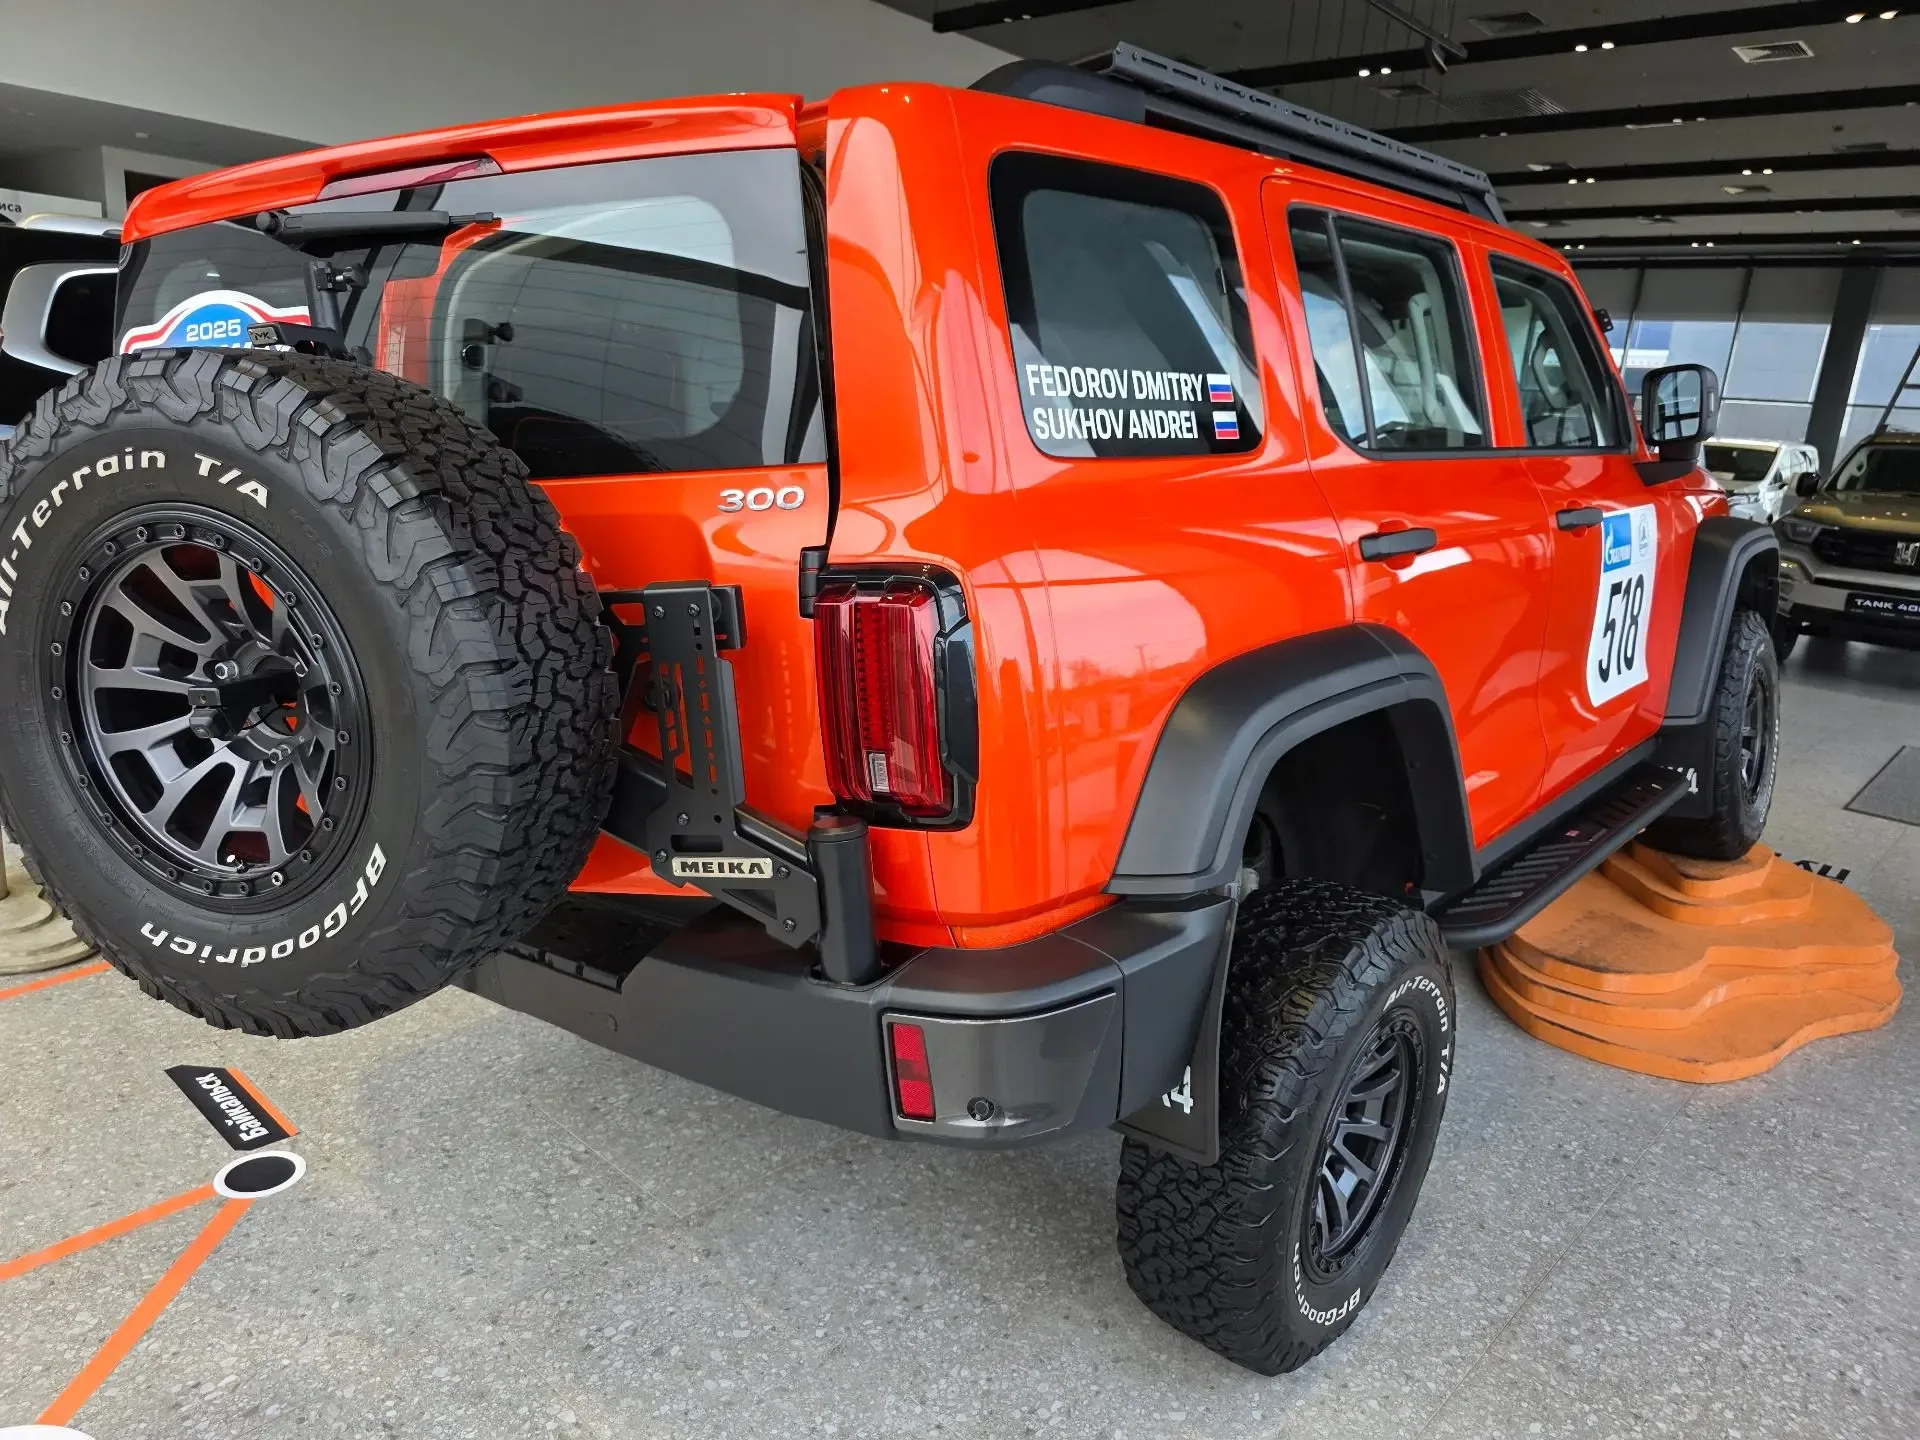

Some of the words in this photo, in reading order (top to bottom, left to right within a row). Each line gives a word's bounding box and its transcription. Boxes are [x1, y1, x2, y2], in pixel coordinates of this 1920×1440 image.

[186, 319, 241, 342] 2025
[1026, 364, 1128, 399] FEDOROV
[1131, 369, 1202, 402] DMITRY
[1033, 407, 1125, 440] SUKHOV
[1128, 409, 1199, 439] ANDREI
[194, 452, 269, 509] T/A
[717, 486, 806, 512] 300
[1598, 573, 1645, 683] 518
[1854, 598, 1894, 610] TANK
[1897, 603, 1920, 612] 40
[680, 861, 765, 875] MEIKA
[140, 842, 388, 968] BFGoodrich
[1382, 975, 1449, 1032] All-Terrain
[1436, 1042, 1450, 1095] T/A
[195, 1072, 270, 1142] Байкальск
[1292, 1241, 1361, 1326] BFGoodrich
